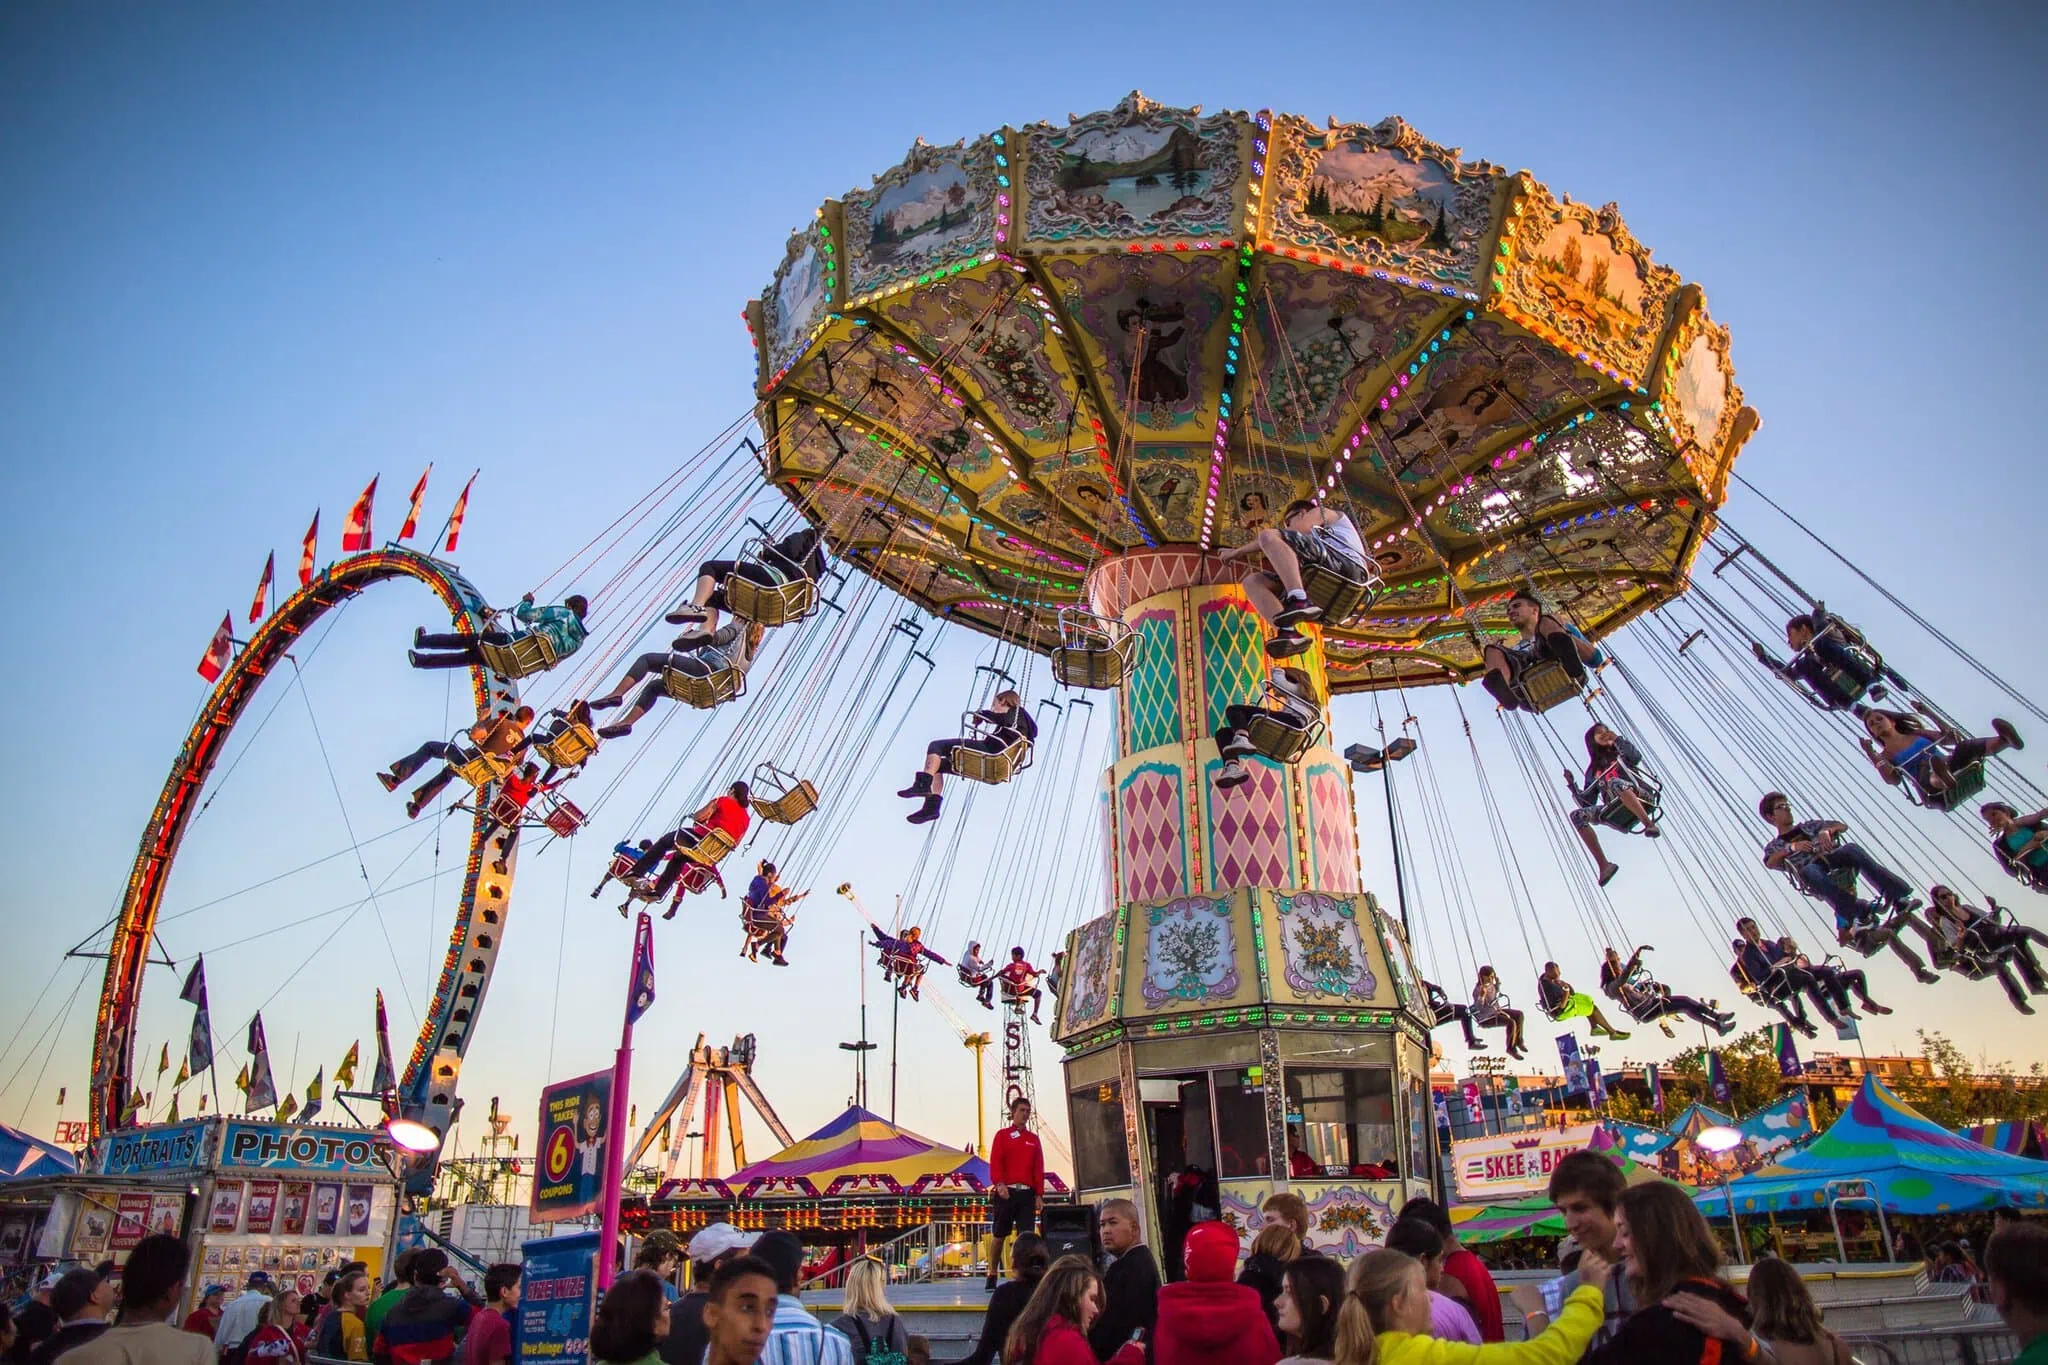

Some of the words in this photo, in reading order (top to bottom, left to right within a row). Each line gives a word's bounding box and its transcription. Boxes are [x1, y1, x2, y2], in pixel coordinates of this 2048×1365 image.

[549, 1099, 564, 1113] THIS
[564, 1095, 581, 1109] RIDE
[553, 1110, 576, 1123] TAKES
[111, 1134, 195, 1167] PORTRAITS
[231, 1132, 394, 1168] PHOTOS
[550, 1132, 568, 1175] 6
[1485, 1153, 1526, 1179] SKEE
[1540, 1146, 1578, 1174] BA
[539, 1183, 574, 1200] COUPONS
